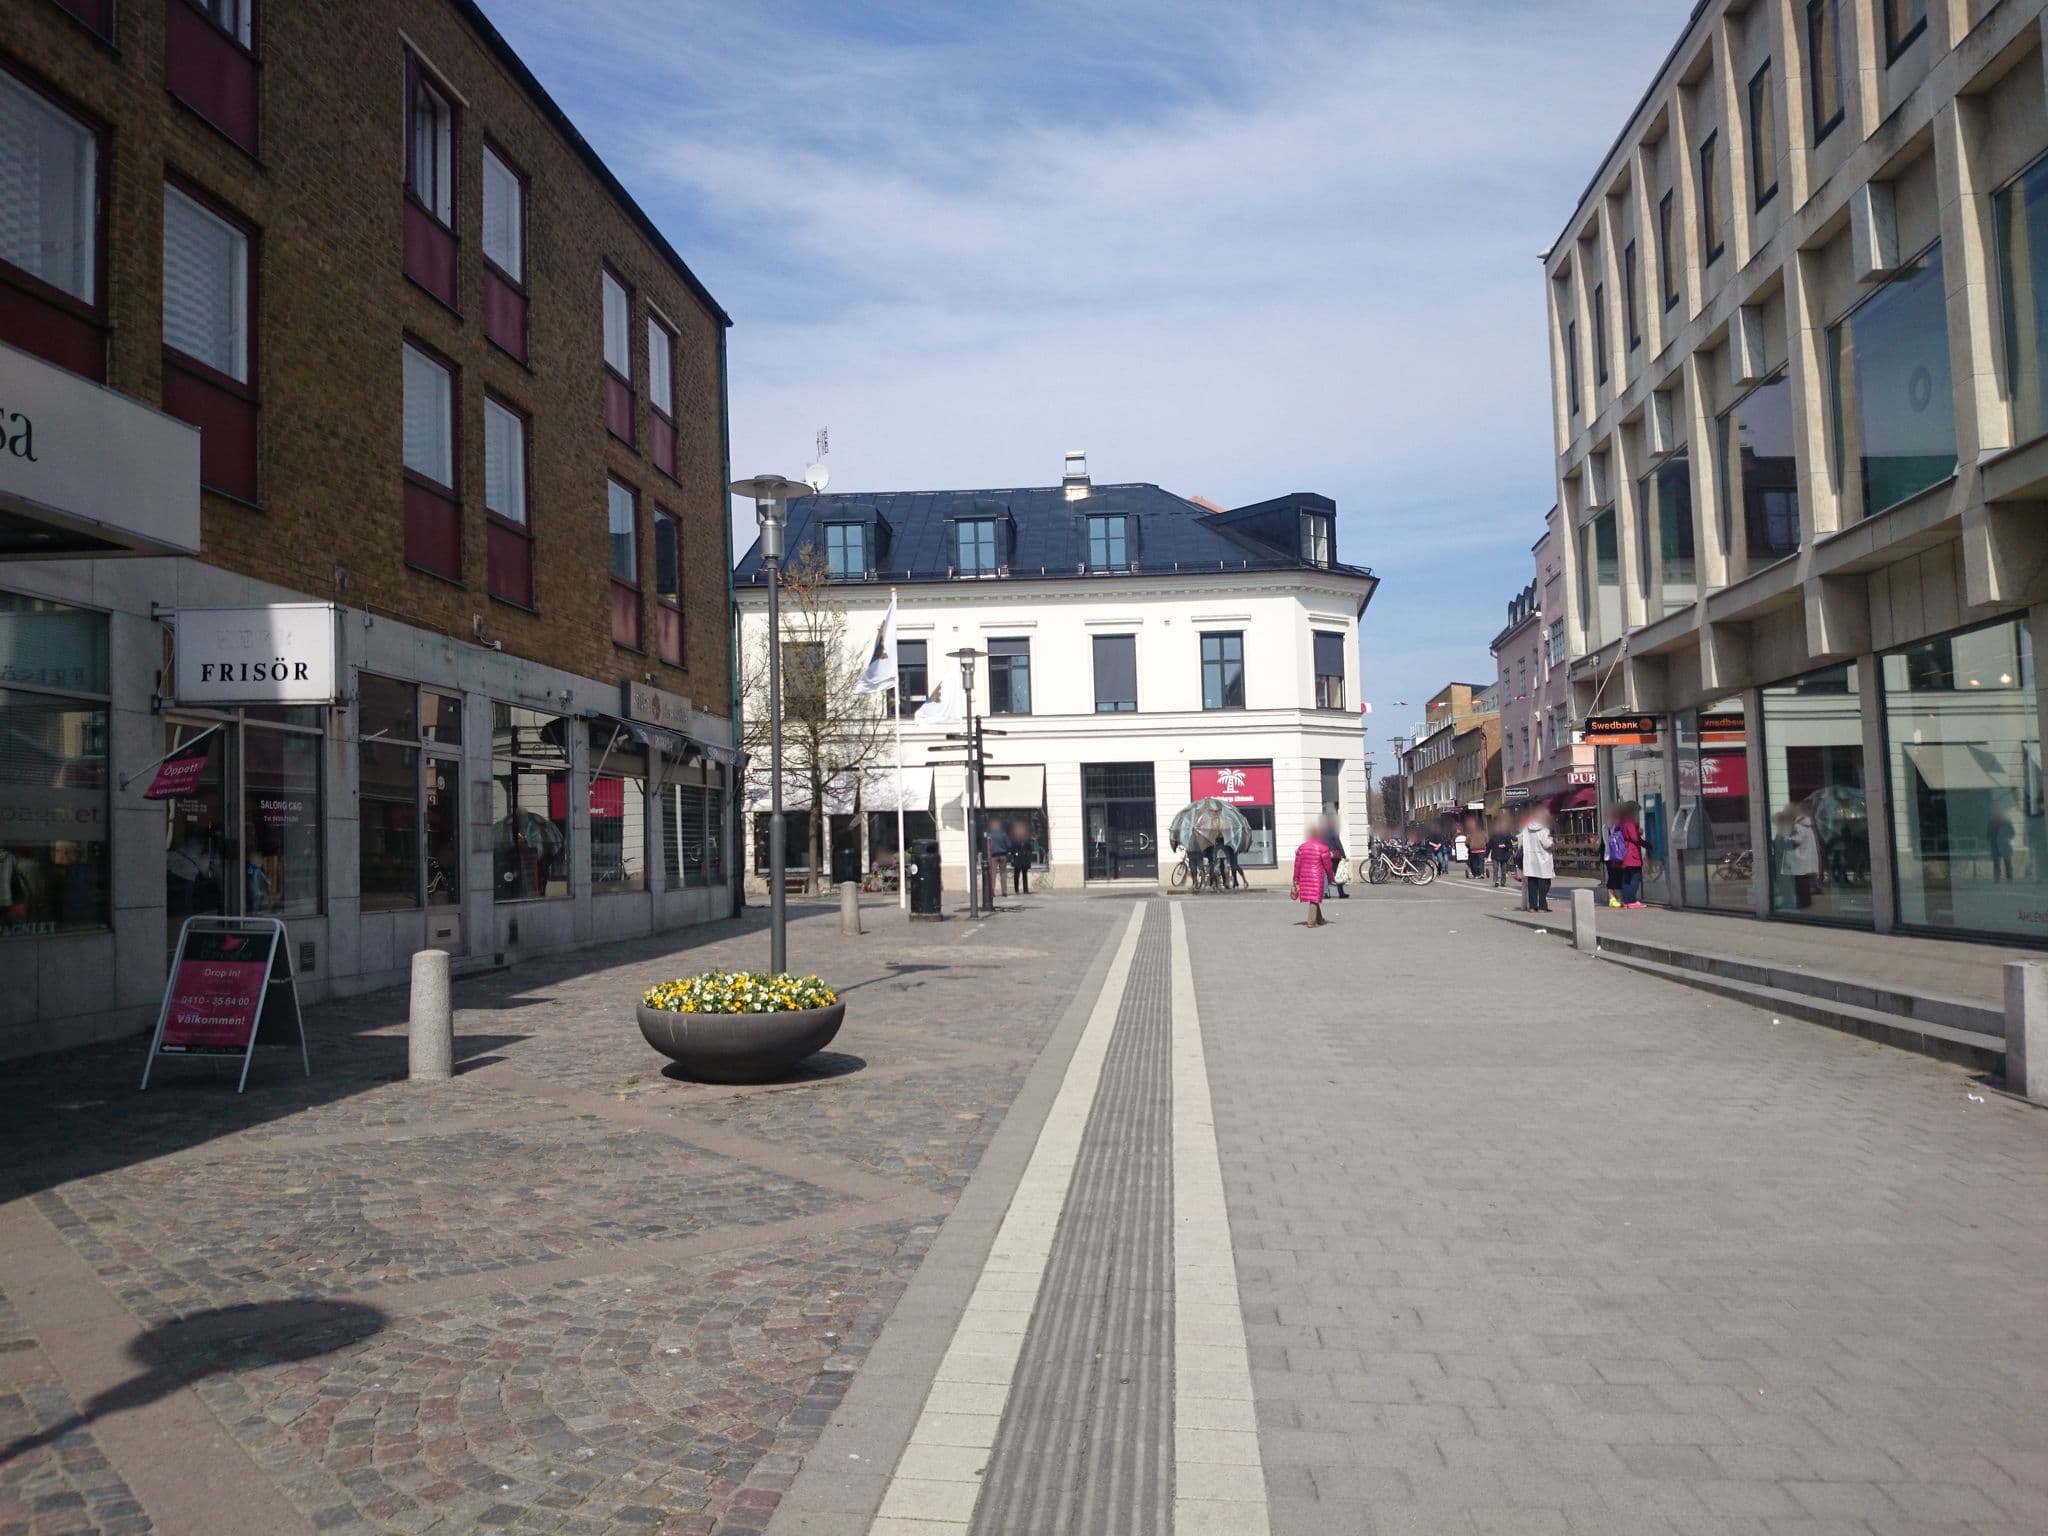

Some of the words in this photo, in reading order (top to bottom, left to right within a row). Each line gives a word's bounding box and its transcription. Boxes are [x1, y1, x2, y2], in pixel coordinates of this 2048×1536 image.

[201, 657, 309, 682] FRISÖR
[1591, 721, 1639, 730] Swedbank
[1571, 773, 1596, 784] PUB
[260, 799, 288, 810] SALONG
[204, 968, 226, 978] Drop
[238, 997, 250, 1006] 00
[177, 1014, 246, 1025] Välkommen!
